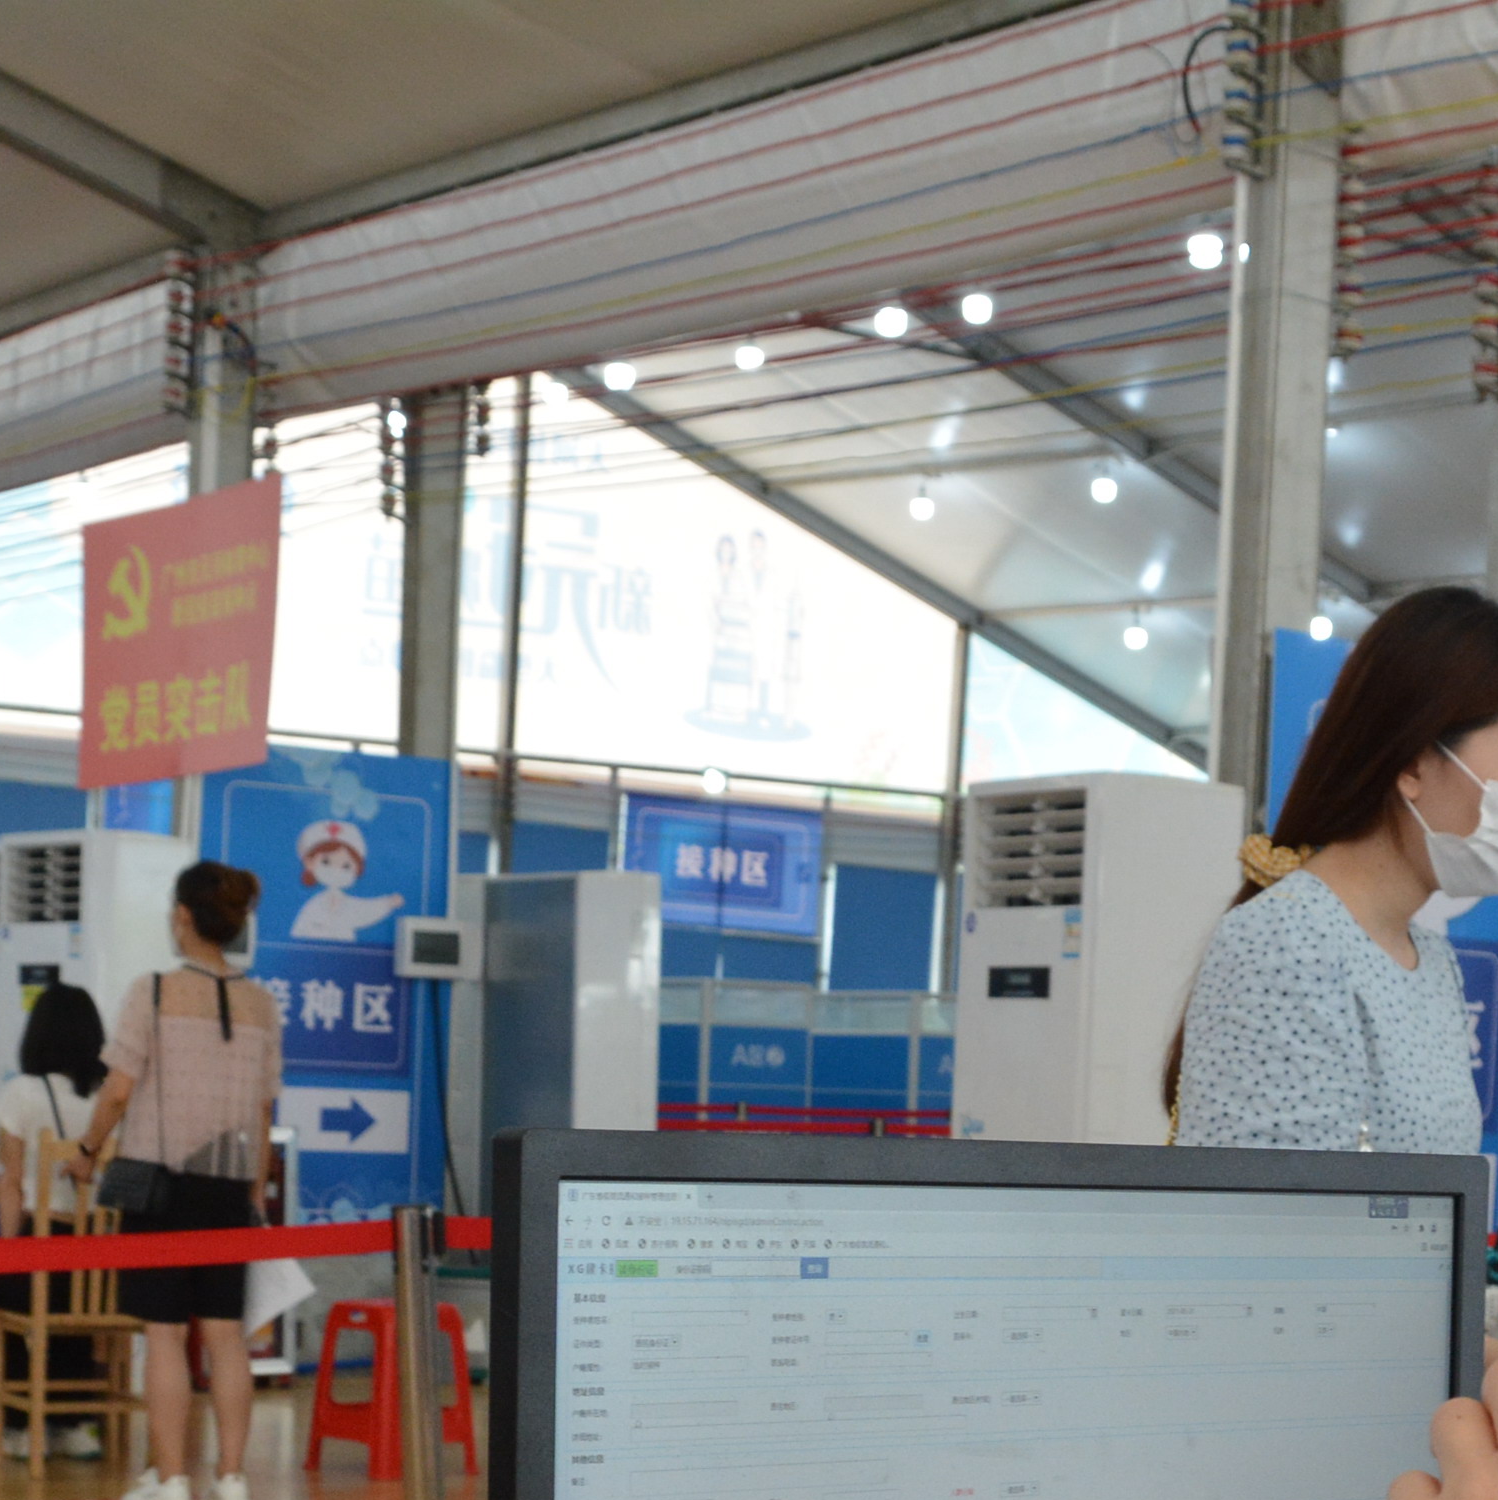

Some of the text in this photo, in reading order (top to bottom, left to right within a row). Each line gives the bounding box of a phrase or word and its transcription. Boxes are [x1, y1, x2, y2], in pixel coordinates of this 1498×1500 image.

[99, 662, 252, 754] 党员突击队
[675, 841, 769, 889] 接种区
